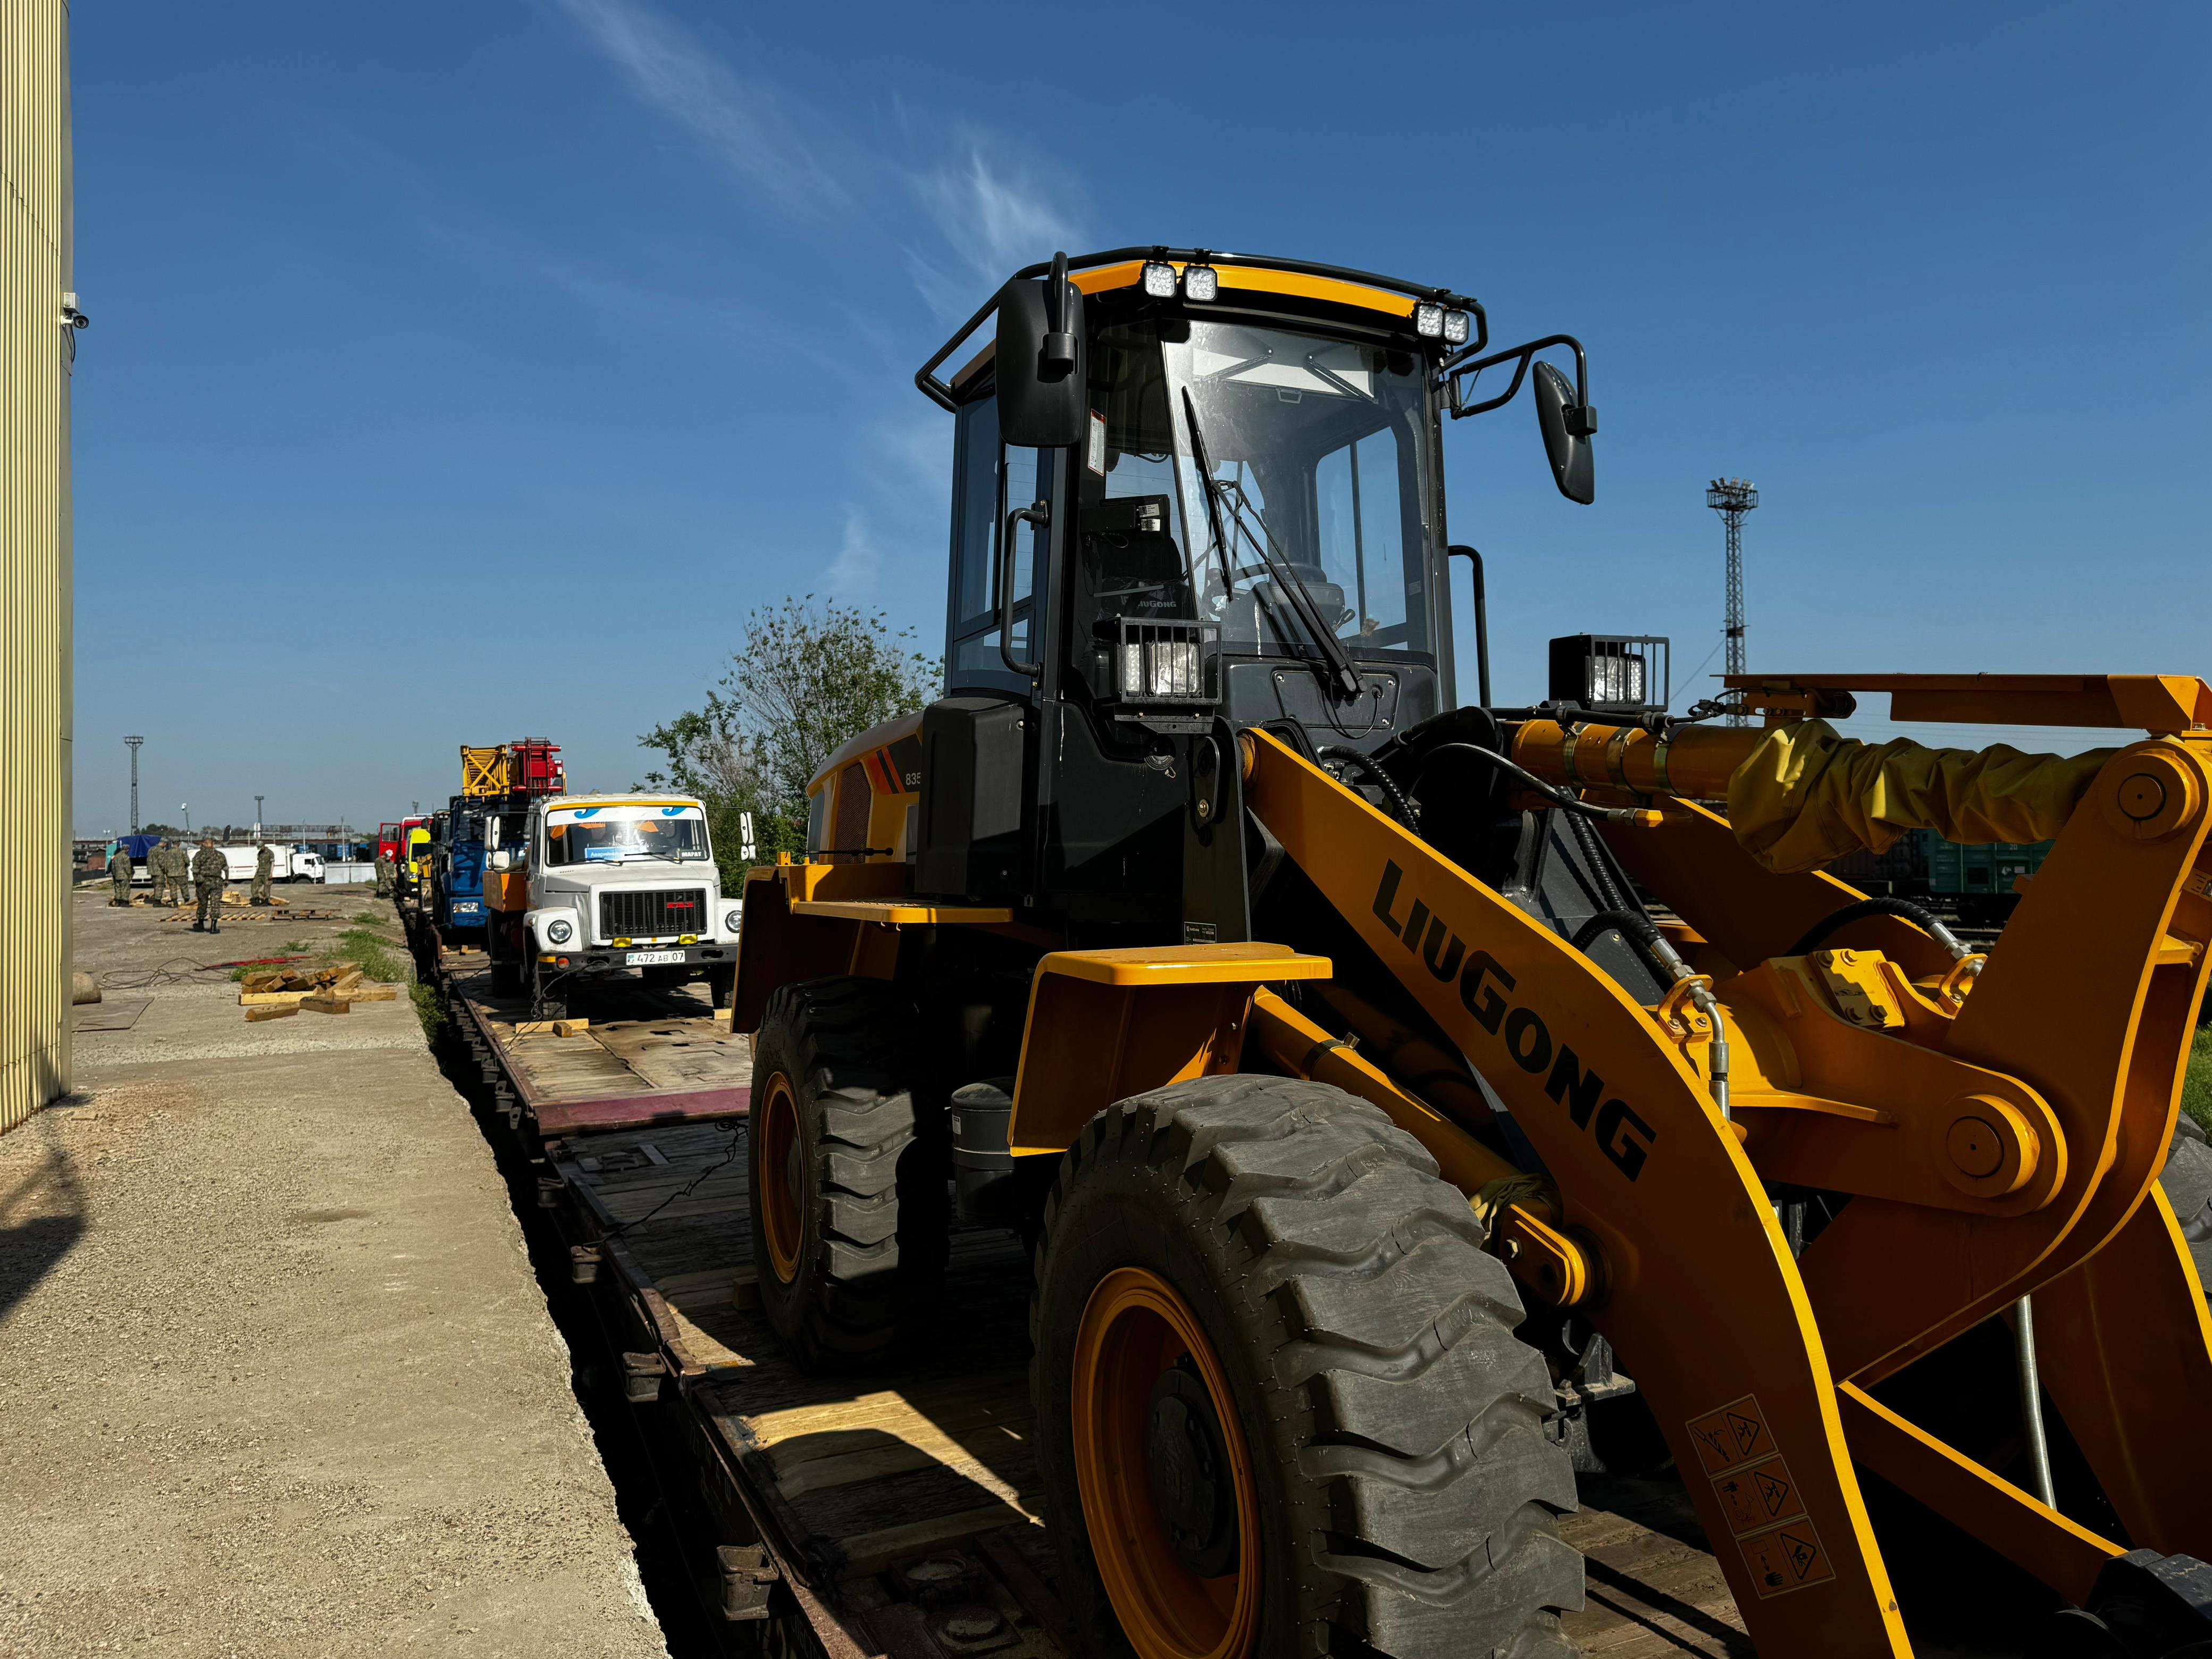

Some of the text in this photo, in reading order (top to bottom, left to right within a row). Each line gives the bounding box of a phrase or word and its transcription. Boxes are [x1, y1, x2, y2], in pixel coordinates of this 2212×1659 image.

[906, 772, 921, 785] 835
[637, 954, 655, 962] 472
[672, 952, 684, 961] 07
[1372, 858, 1657, 1182] LIUGONG
